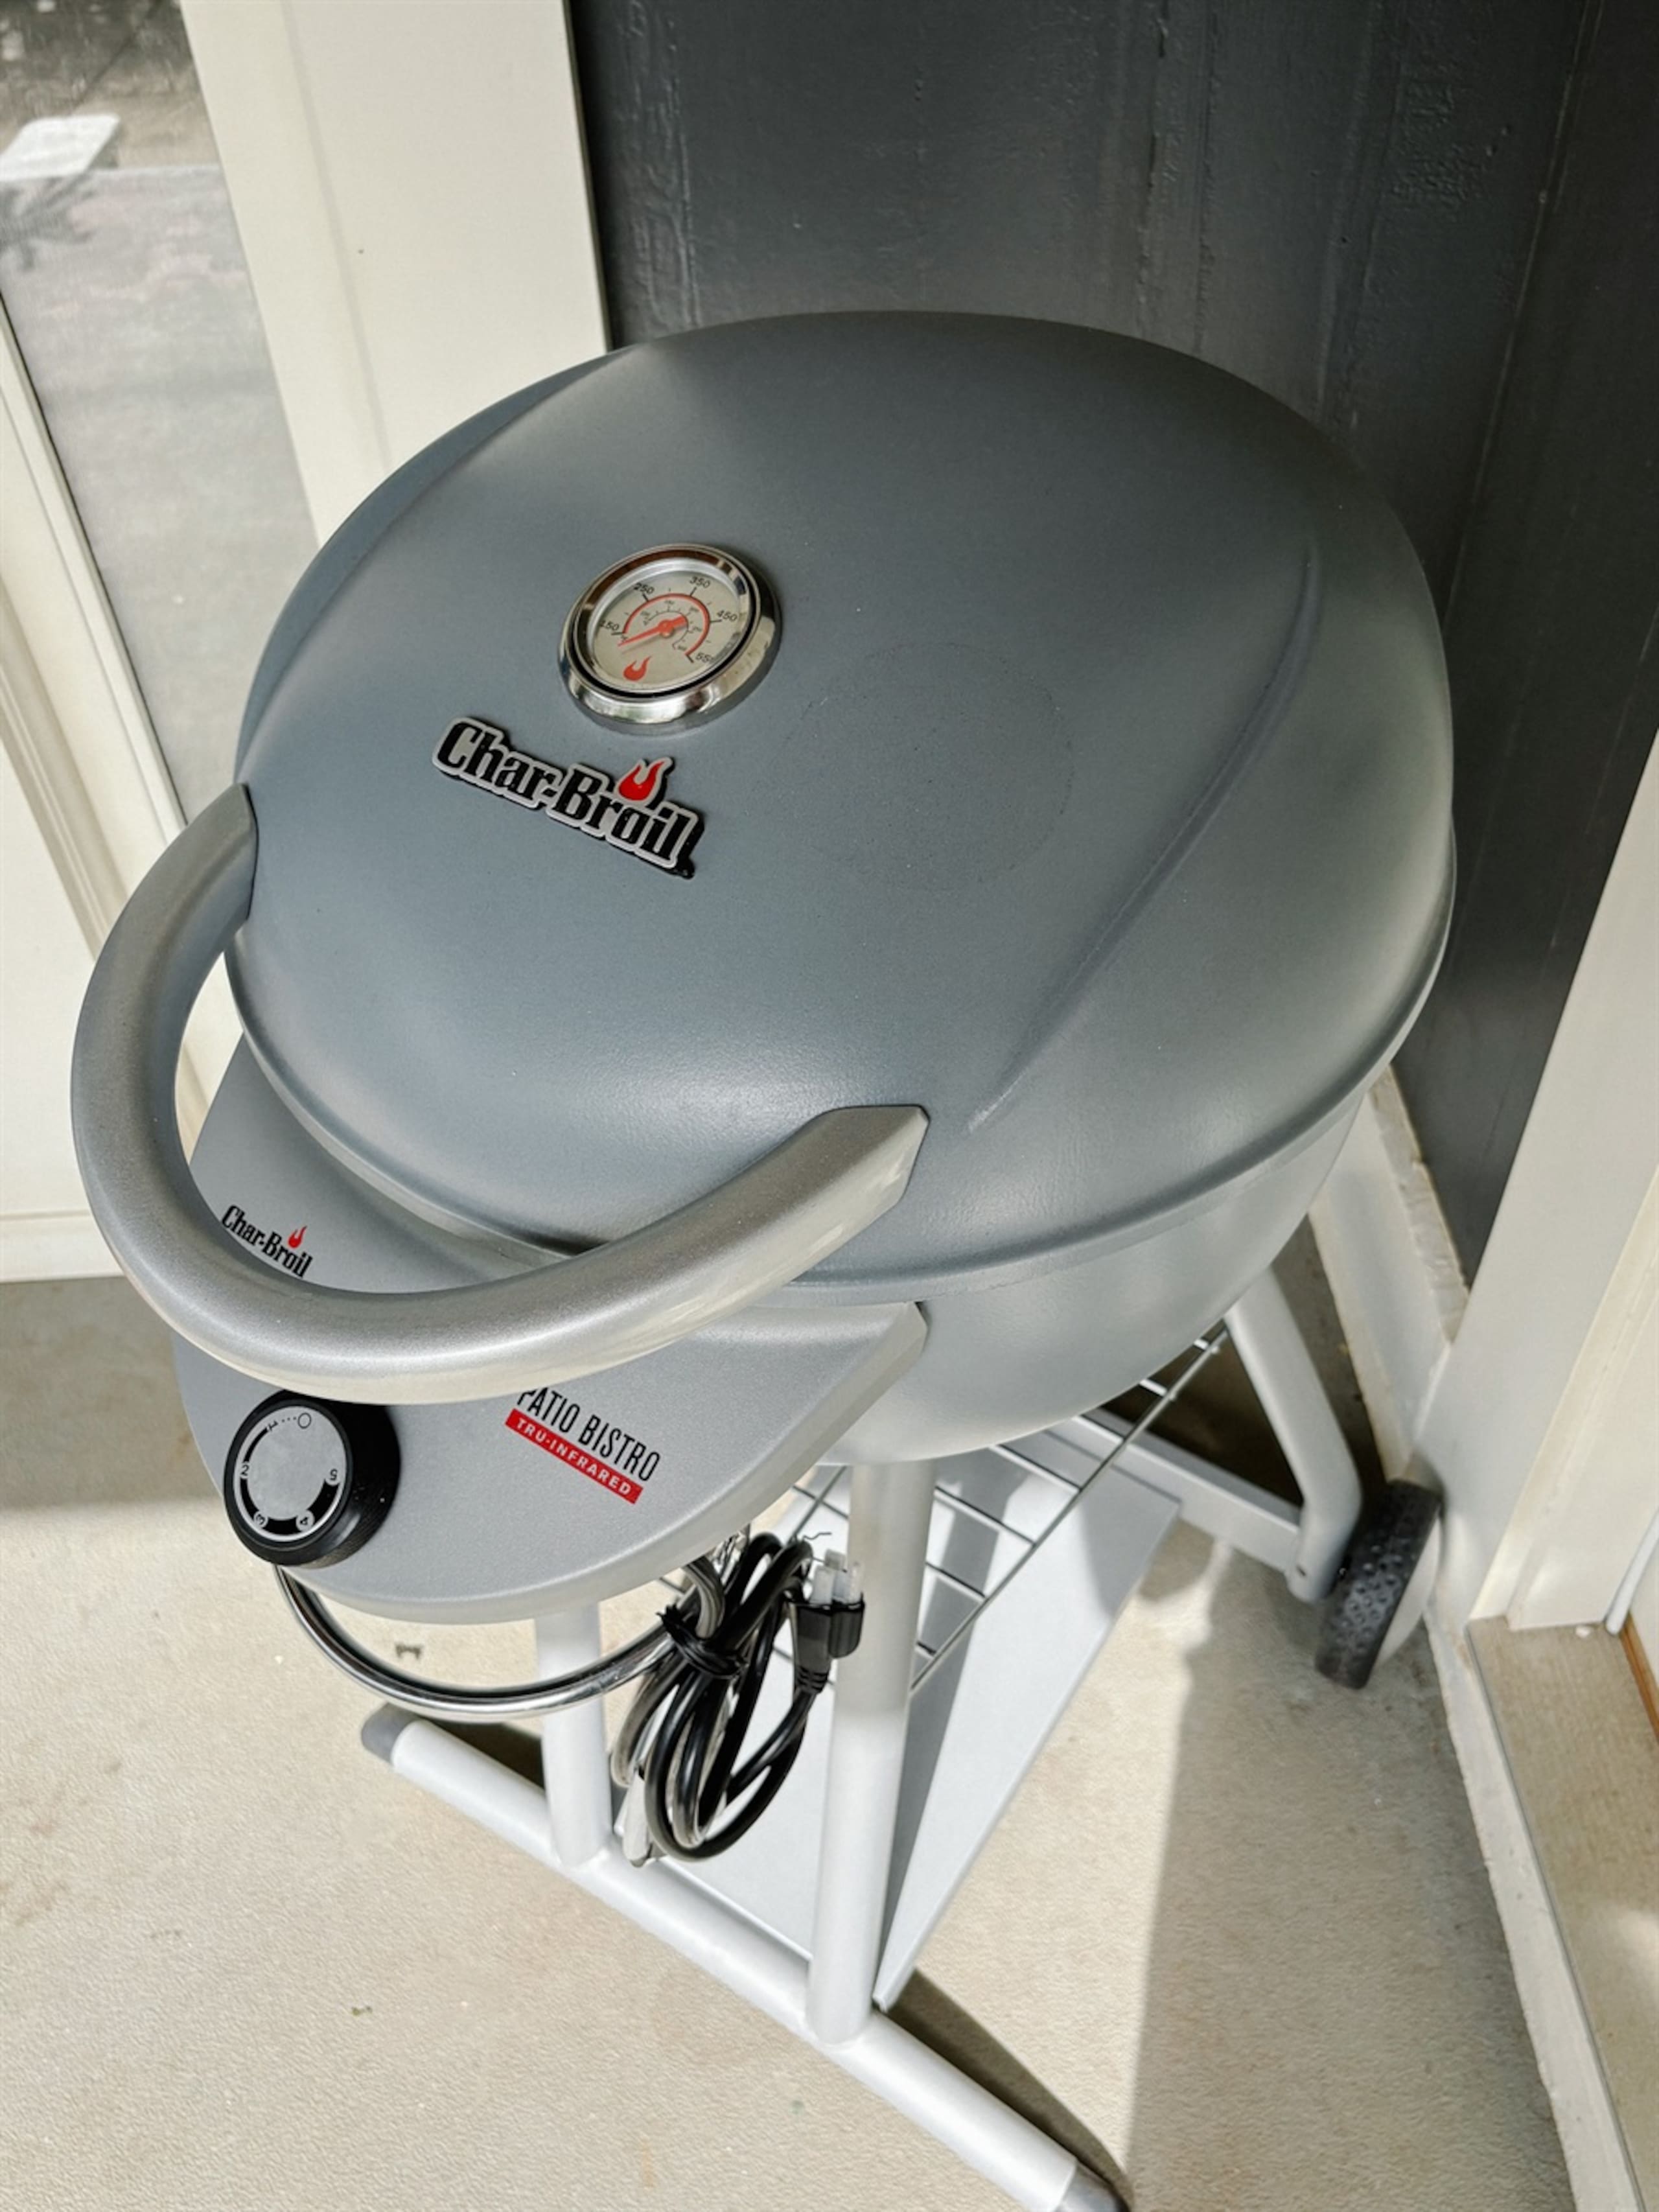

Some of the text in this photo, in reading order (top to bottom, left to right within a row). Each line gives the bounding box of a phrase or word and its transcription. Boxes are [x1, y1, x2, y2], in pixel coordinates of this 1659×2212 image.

[690, 576, 710, 588] 350
[634, 583, 655, 594] 250
[717, 610, 737, 621] 450
[434, 718, 697, 867] Char-Broil
[222, 1205, 313, 1277] Char-Broil
[578, 1414, 660, 1481] BISTRO
[240, 1464, 249, 1476] 2
[329, 1469, 338, 1481] 5
